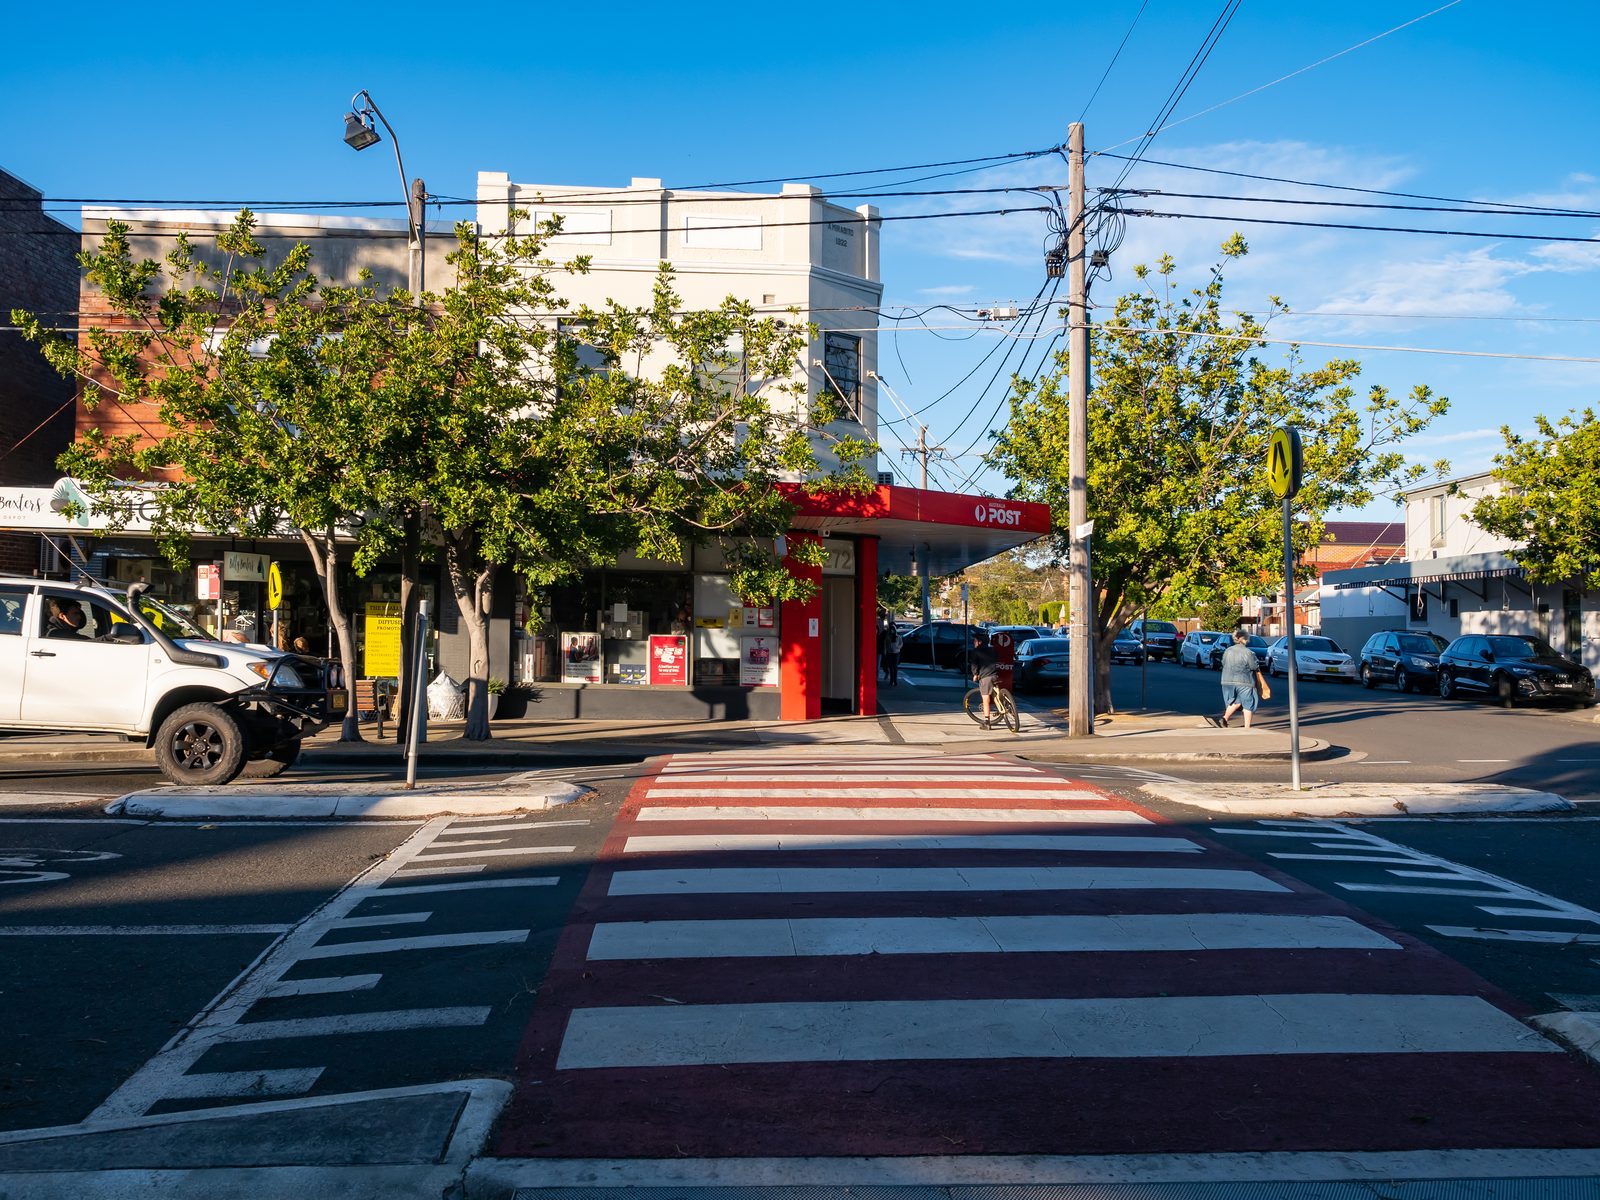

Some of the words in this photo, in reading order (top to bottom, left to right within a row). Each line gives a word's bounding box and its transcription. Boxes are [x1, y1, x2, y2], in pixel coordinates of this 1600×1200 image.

[0, 493, 44, 514] Baxters
[988, 508, 1022, 526] POST
[824, 548, 851, 569] 72
